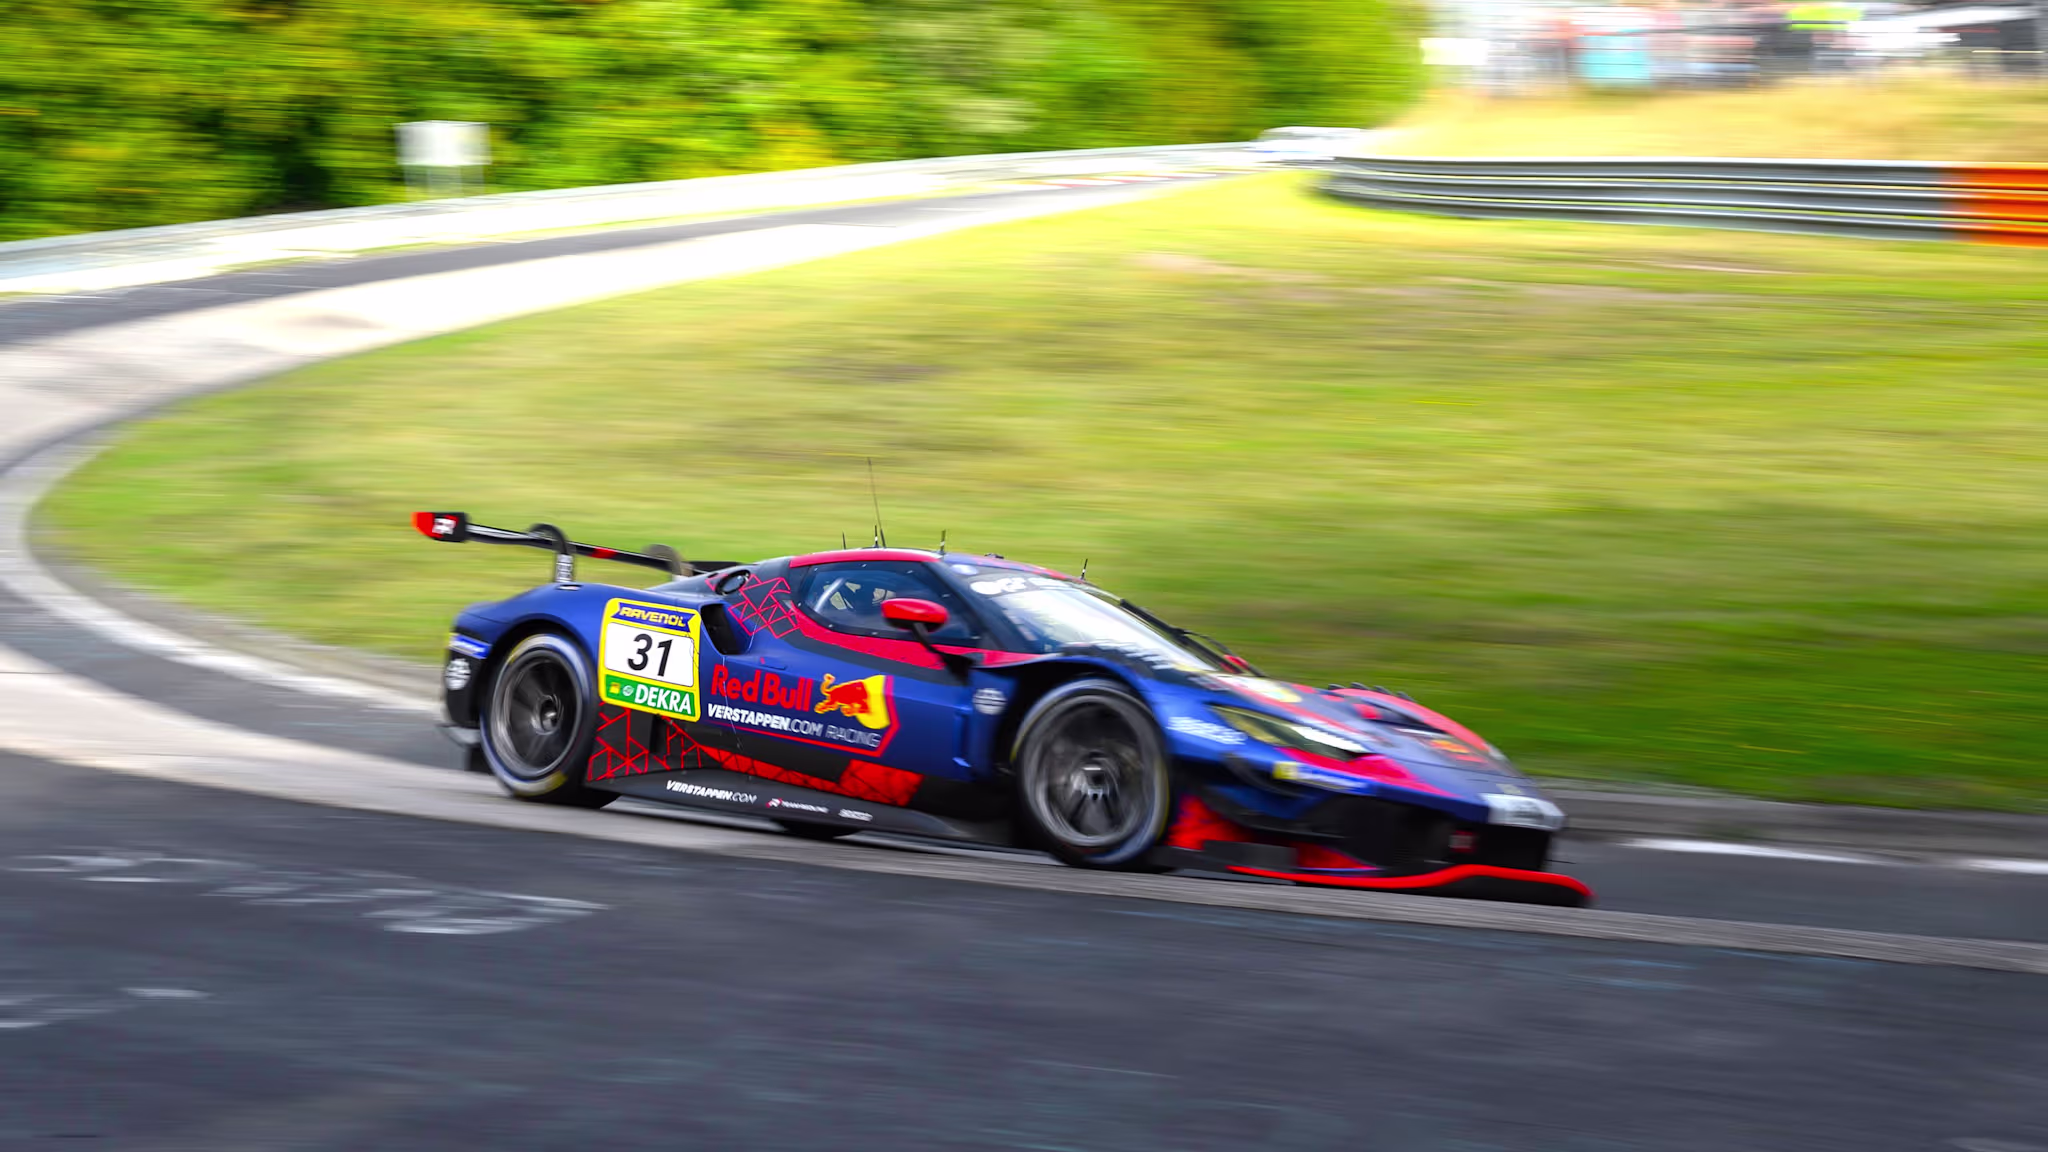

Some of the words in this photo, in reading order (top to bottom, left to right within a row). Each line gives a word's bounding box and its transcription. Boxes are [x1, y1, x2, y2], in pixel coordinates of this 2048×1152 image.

[619, 606, 686, 627] RAVENOL
[627, 633, 673, 677] 31
[634, 684, 692, 715] DEKRA
[711, 664, 761, 703] Red
[761, 672, 814, 712] Bull
[707, 703, 823, 737] VERSTAPPEN.COM
[825, 724, 882, 748] RACING
